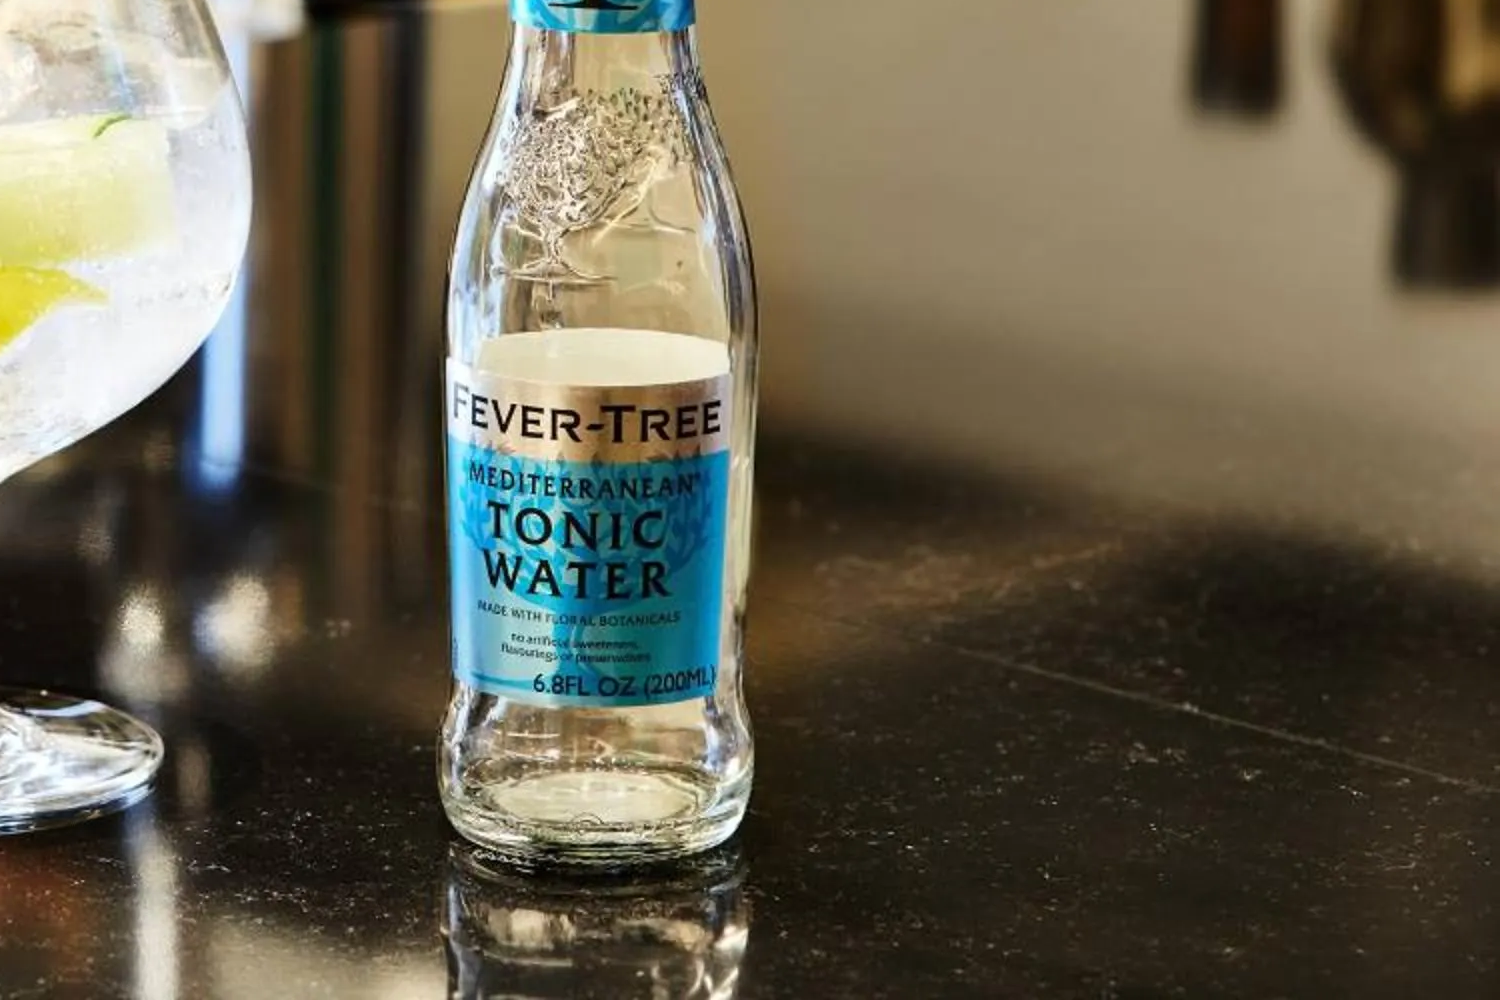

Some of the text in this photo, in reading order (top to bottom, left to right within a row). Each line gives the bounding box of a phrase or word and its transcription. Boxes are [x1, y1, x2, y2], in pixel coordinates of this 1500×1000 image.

[453, 381, 722, 444] FEVER-TREE
[468, 460, 694, 499] MEDITERRANEAN
[486, 499, 665, 551] TONIC
[481, 548, 674, 600] WATER
[477, 599, 682, 627] MADE WITH FLORAL BOTANICALS
[533, 663, 716, 699] 6.8FL OZ (200ML)
